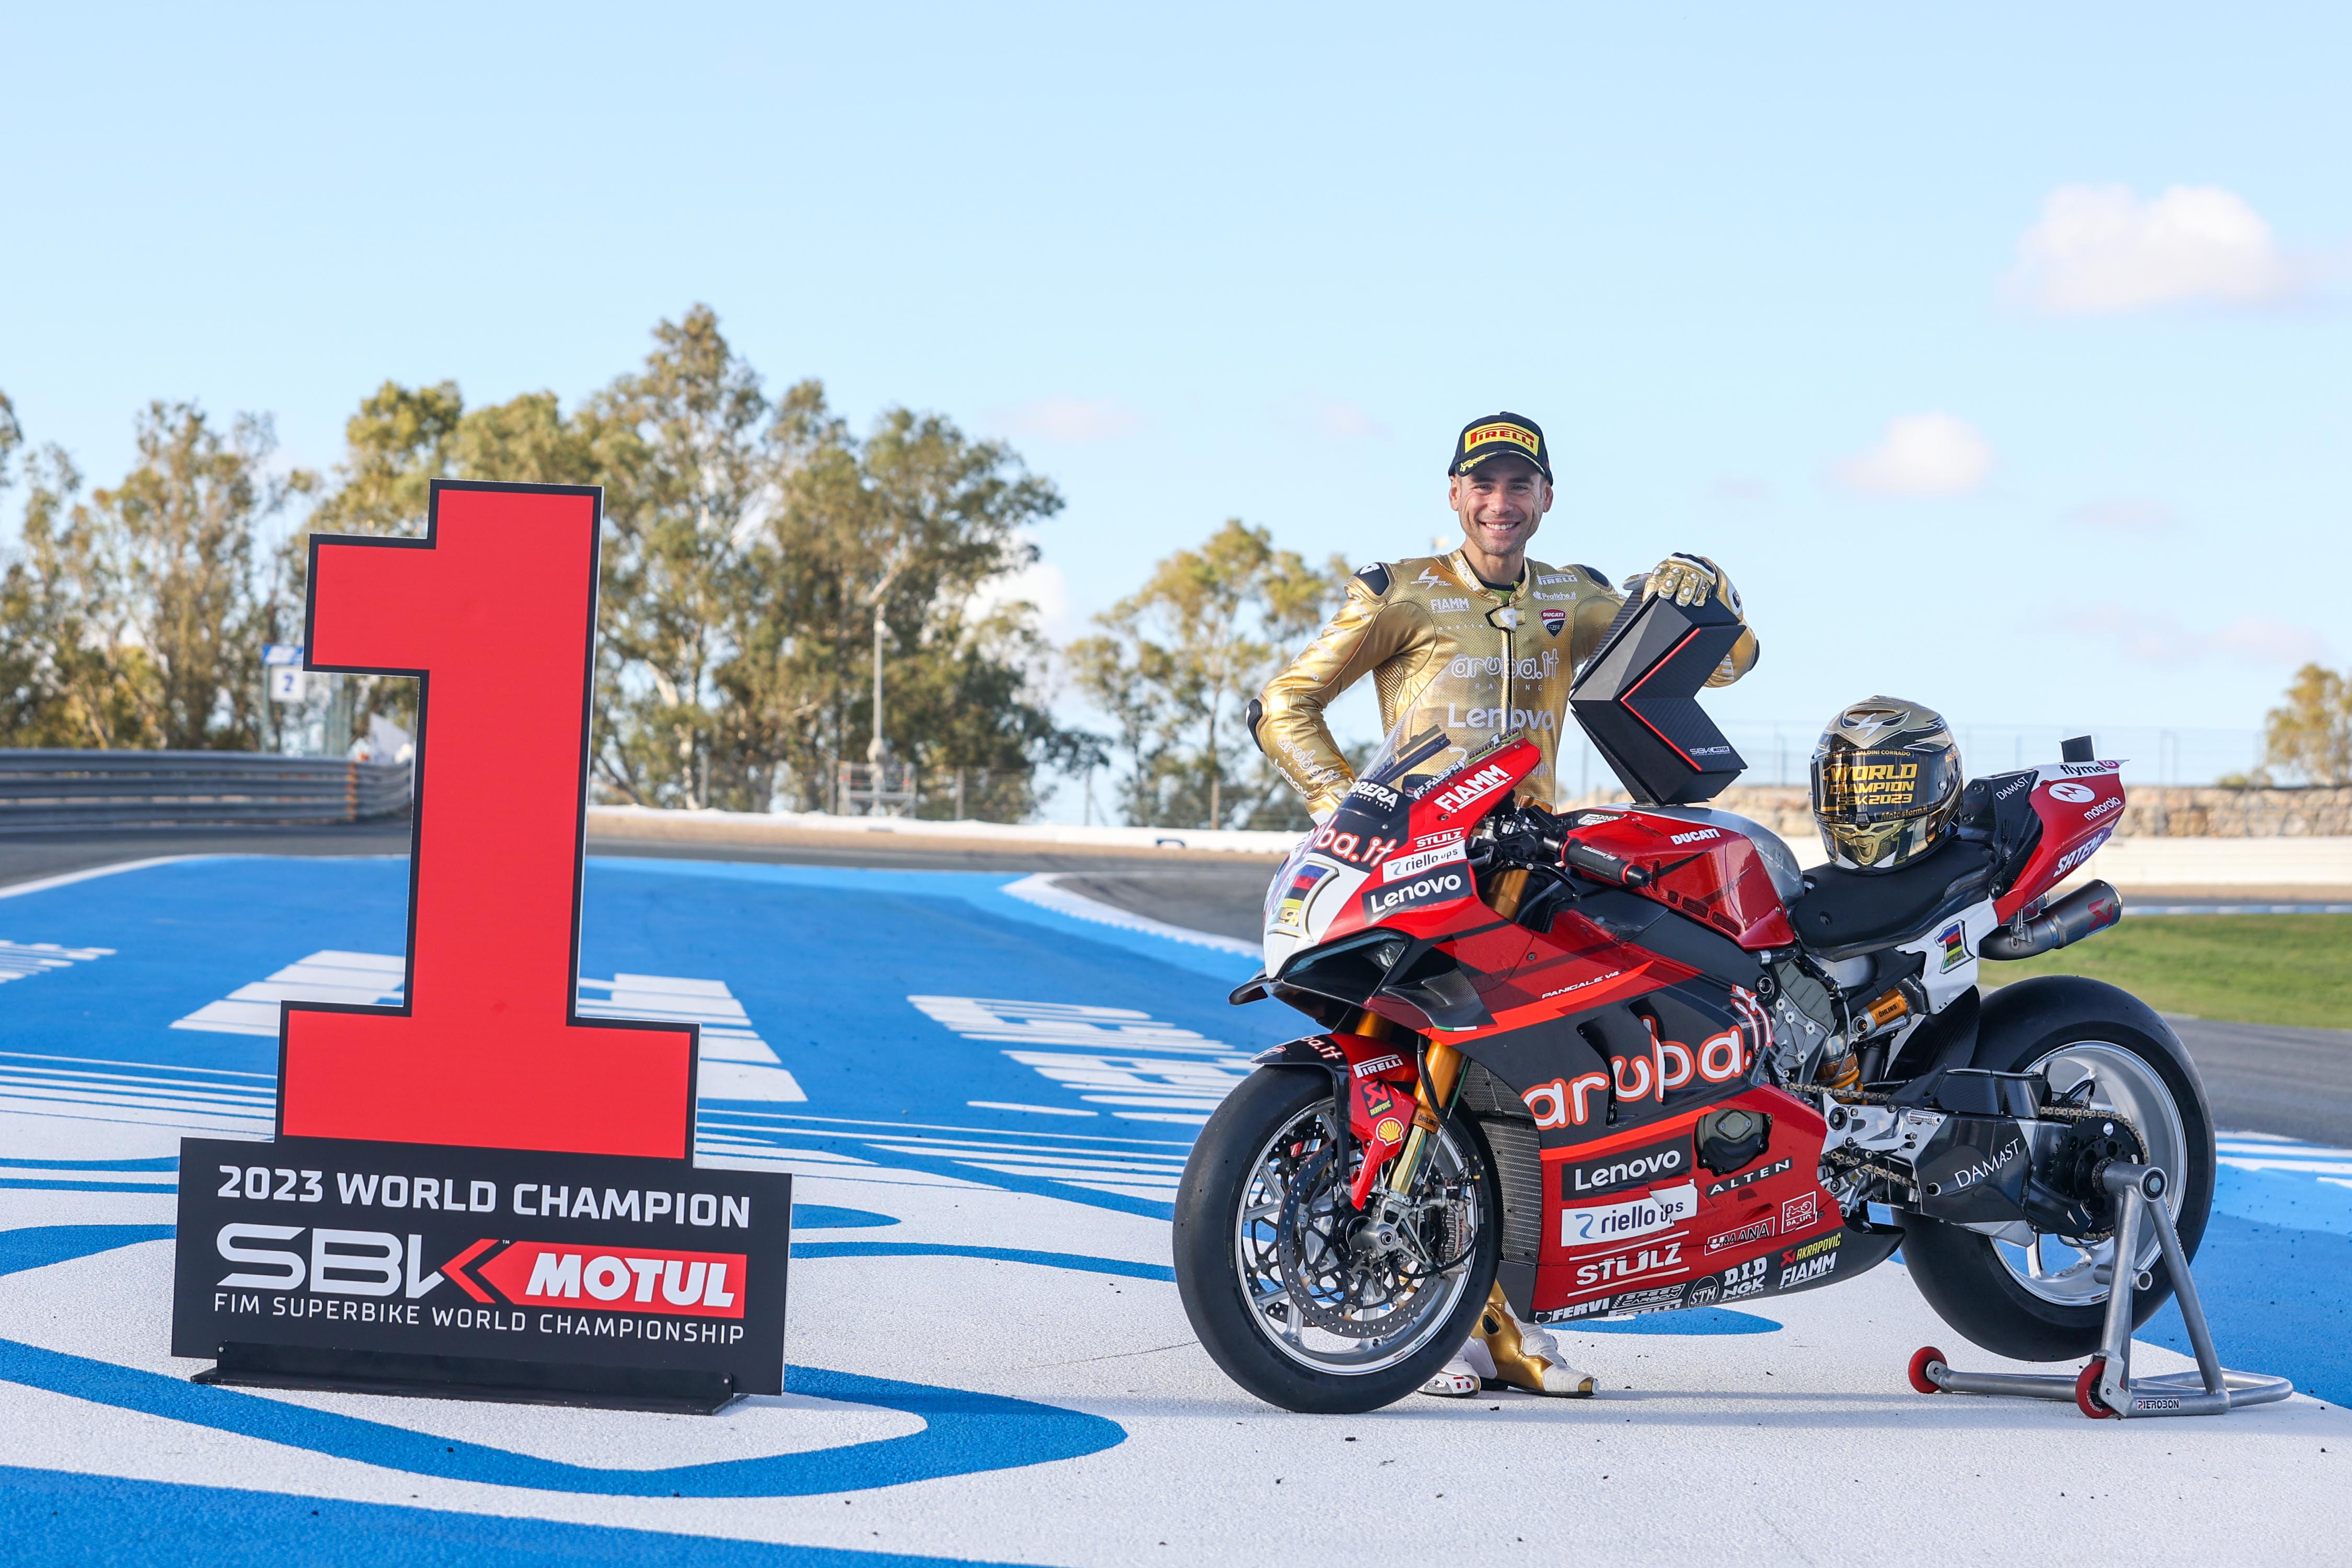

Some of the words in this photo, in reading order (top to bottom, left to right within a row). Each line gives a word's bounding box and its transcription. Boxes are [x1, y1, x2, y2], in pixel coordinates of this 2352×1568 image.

[1470, 425, 1535, 448] PIRELLI
[1537, 574, 1577, 585] PIRELLI
[1430, 597, 1470, 612] FIAMM
[283, 674, 294, 691] 2
[1448, 702, 1554, 730] Lenovo
[1274, 758, 1313, 800] Lenovo
[1831, 764, 1918, 782] WORLD
[2060, 764, 2107, 776] flyme
[1434, 764, 1510, 811] FIAMM
[1996, 776, 2029, 800] DAMAST
[279, 479, 699, 1161] 1
[2084, 797, 2122, 821] motorola
[1416, 831, 1461, 848] STULZ
[1670, 828, 1721, 845] DUCATI
[1405, 854, 1438, 871] riello
[1441, 849, 1458, 860] ups
[1370, 874, 1461, 913] Lenovo
[1542, 975, 1602, 999] PANIGALE
[1605, 971, 1620, 981] V4
[1353, 1054, 1403, 1078] PIRELLI
[1520, 984, 1774, 1131] aruba.it
[1575, 1150, 1681, 1191] Lenovo
[1954, 1138, 2020, 1189] DAMAST
[1710, 1159, 1790, 1195] ALTEN
[217, 1165, 324, 1203] 2023
[338, 1172, 496, 1213] WORLD
[513, 1182, 751, 1229] CHAMPION
[1601, 1205, 1656, 1234] riello
[216, 1223, 500, 1304] SBK
[525, 1252, 736, 1308] MOTUL
[1576, 1242, 1682, 1286] STULZ
[1725, 1256, 1768, 1286] D.I.D
[1780, 1251, 1837, 1287] FIAMM
[1626, 1286, 1681, 1300] SPEED
[1690, 1287, 1717, 1305] STM
[1722, 1275, 1766, 1299] NGK
[1743, 1288, 1764, 1298] PLUGS
[1552, 1297, 1610, 1321] FERVI
[1622, 1294, 1679, 1306] CARBON
[214, 1294, 260, 1316] FIM
[272, 1297, 420, 1324] SUPERBIKE
[433, 1306, 526, 1331] WORLD
[539, 1314, 745, 1345] CHAMPIONSHIP
[2137, 1399, 2180, 1410] PIEROBON
